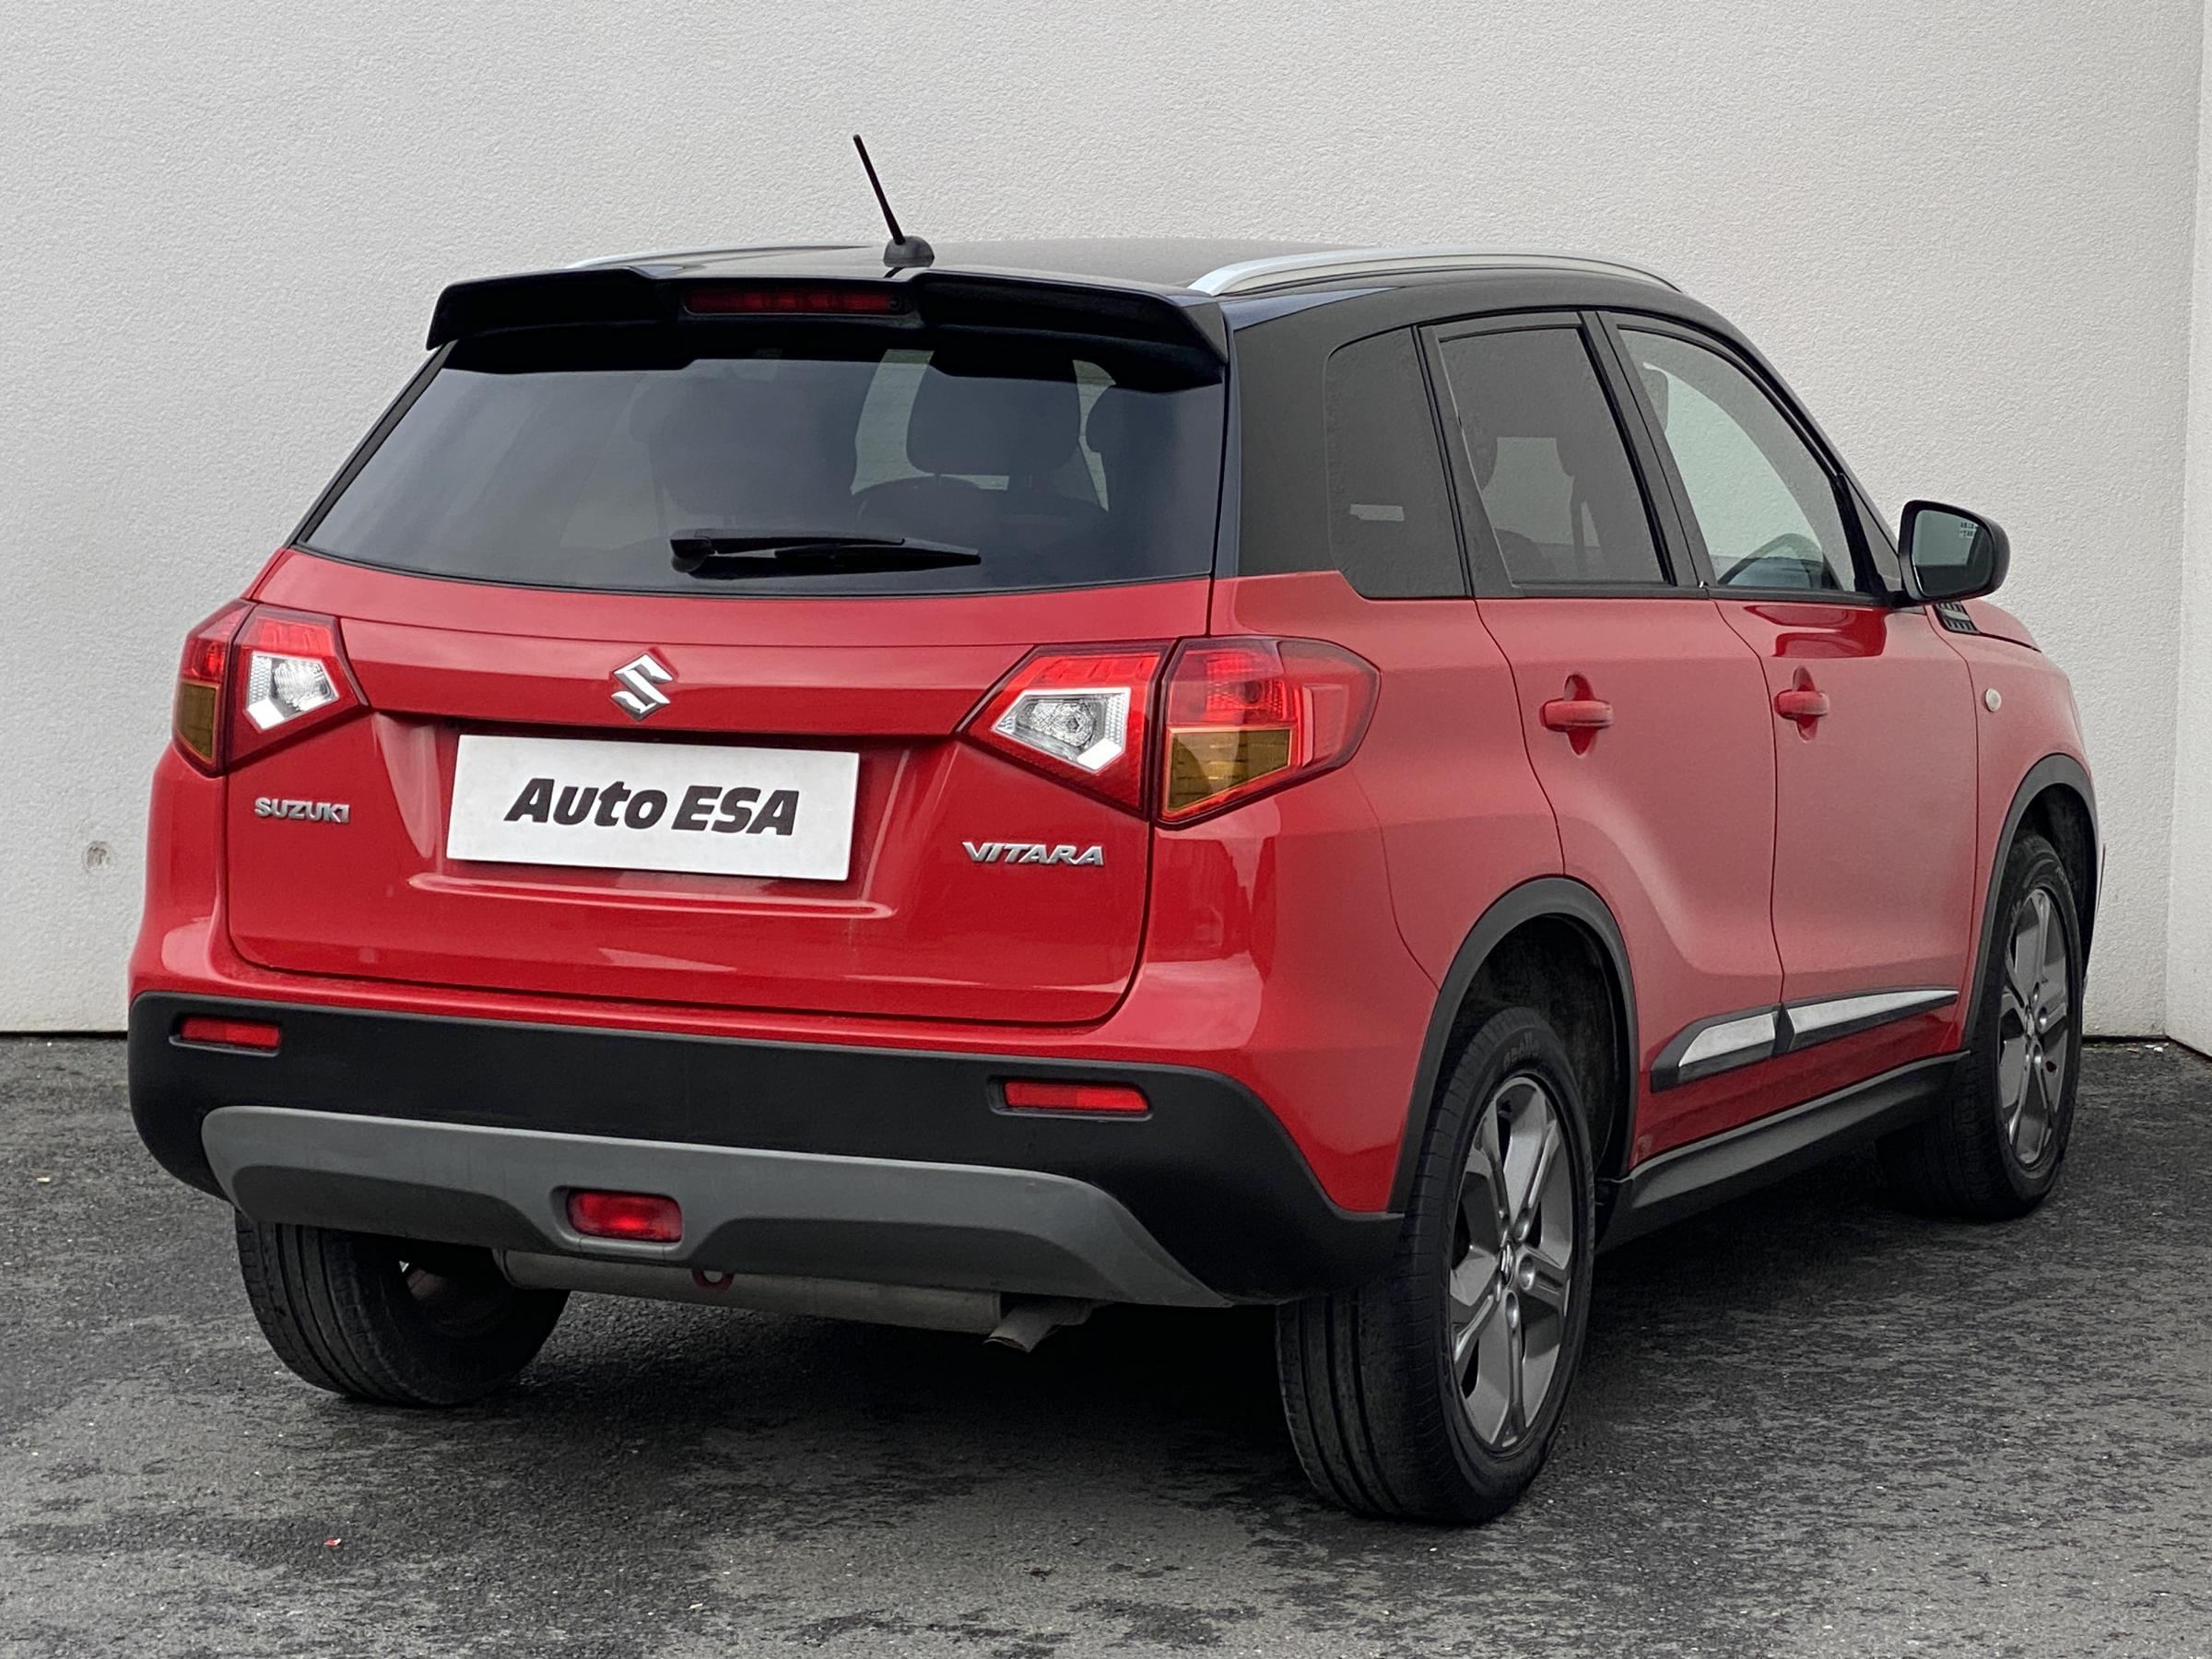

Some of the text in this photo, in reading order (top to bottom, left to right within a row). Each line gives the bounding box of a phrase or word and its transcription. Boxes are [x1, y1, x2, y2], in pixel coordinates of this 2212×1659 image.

[254, 797, 350, 823] SUZUKI
[503, 778, 799, 836] Auto ESA
[962, 841, 1104, 865] VITARA
